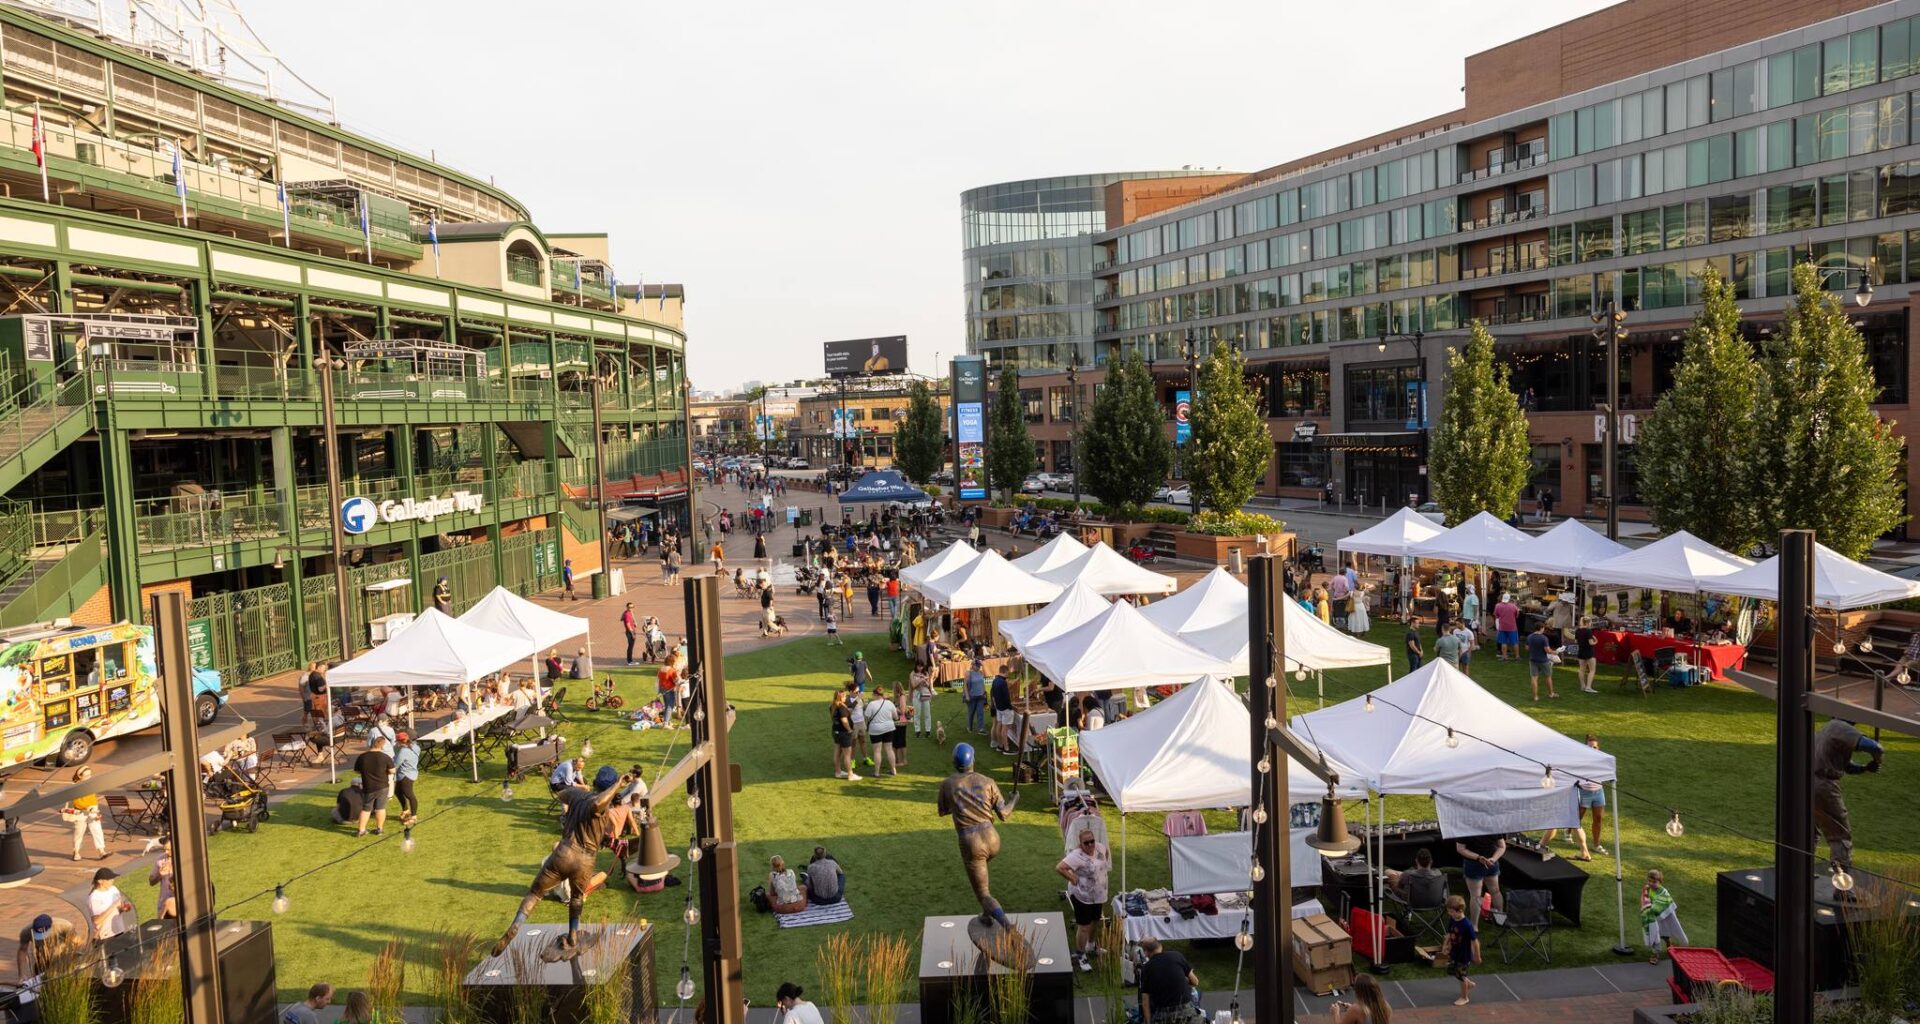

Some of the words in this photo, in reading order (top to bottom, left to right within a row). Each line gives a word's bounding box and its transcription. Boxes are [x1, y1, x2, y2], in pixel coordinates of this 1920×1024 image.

[890, 484, 905, 492] Way
[379, 495, 455, 523] Gallagher
[452, 490, 483, 514] Way
